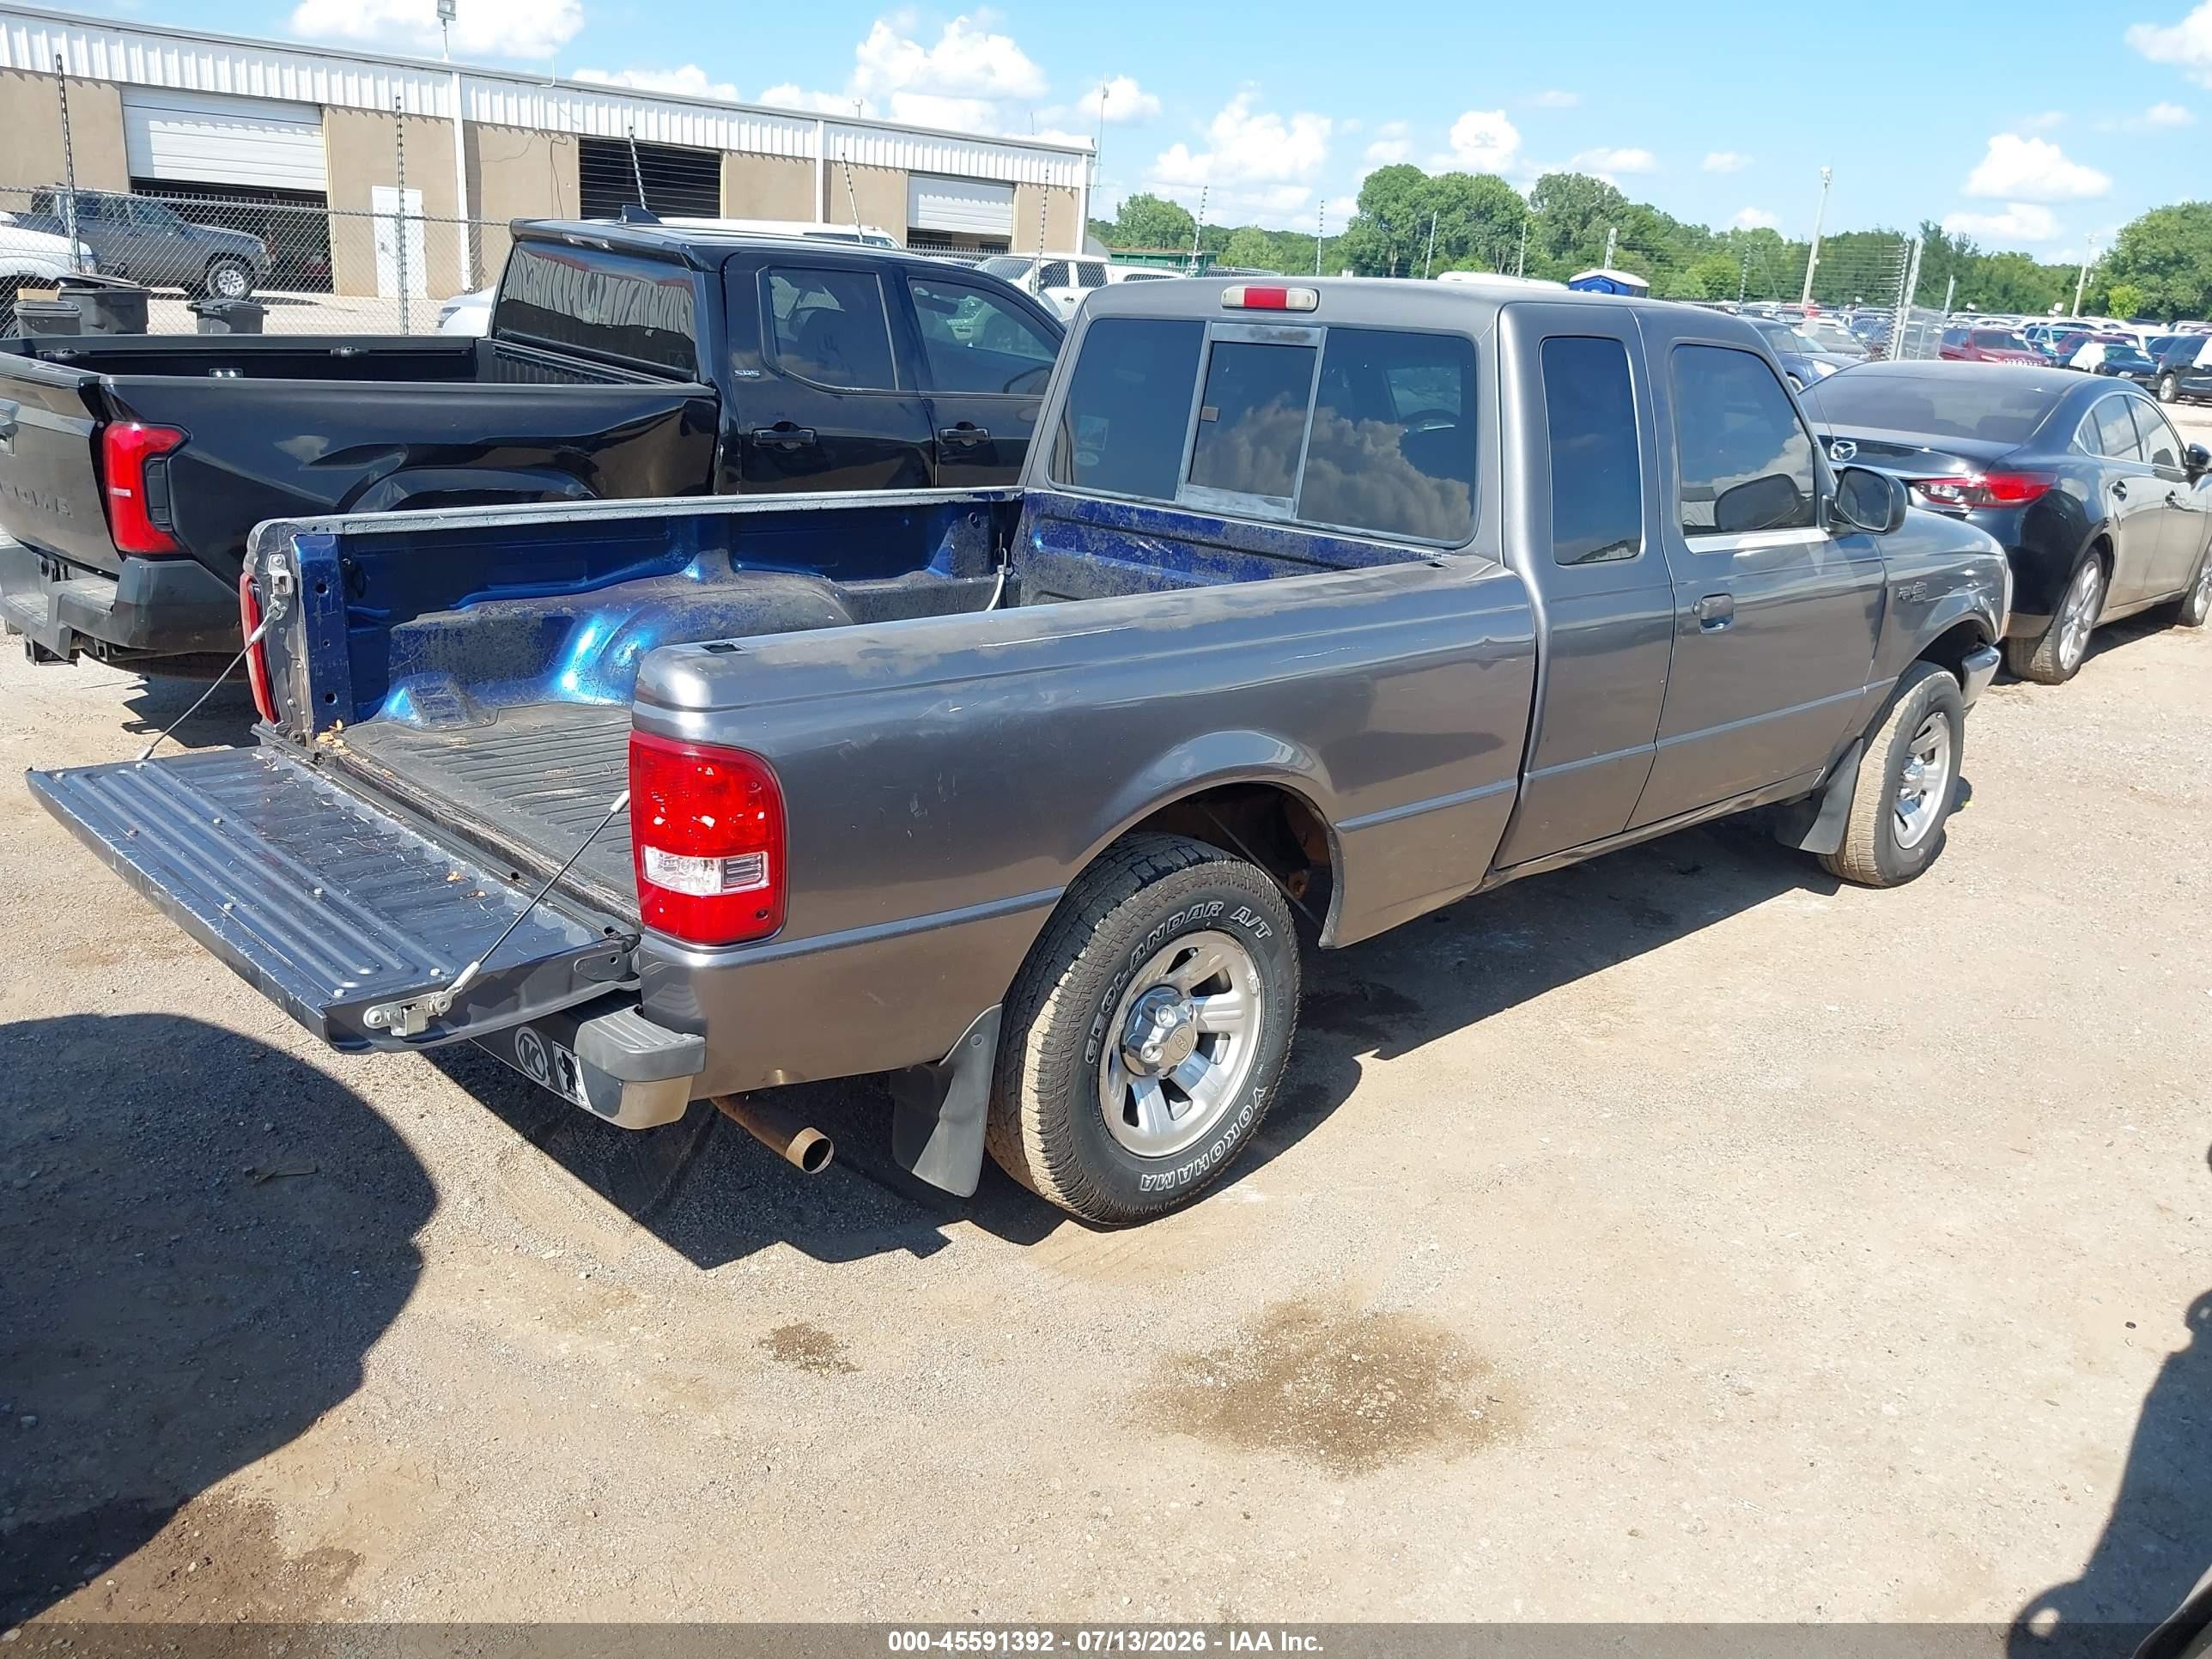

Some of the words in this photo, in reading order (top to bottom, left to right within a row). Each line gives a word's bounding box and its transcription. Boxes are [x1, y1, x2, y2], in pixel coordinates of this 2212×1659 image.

[1085, 901, 1224, 1065] GEOLANDAR
[1230, 905, 1273, 939] A/T
[1139, 1085, 1268, 1192] YOKOHAMA
